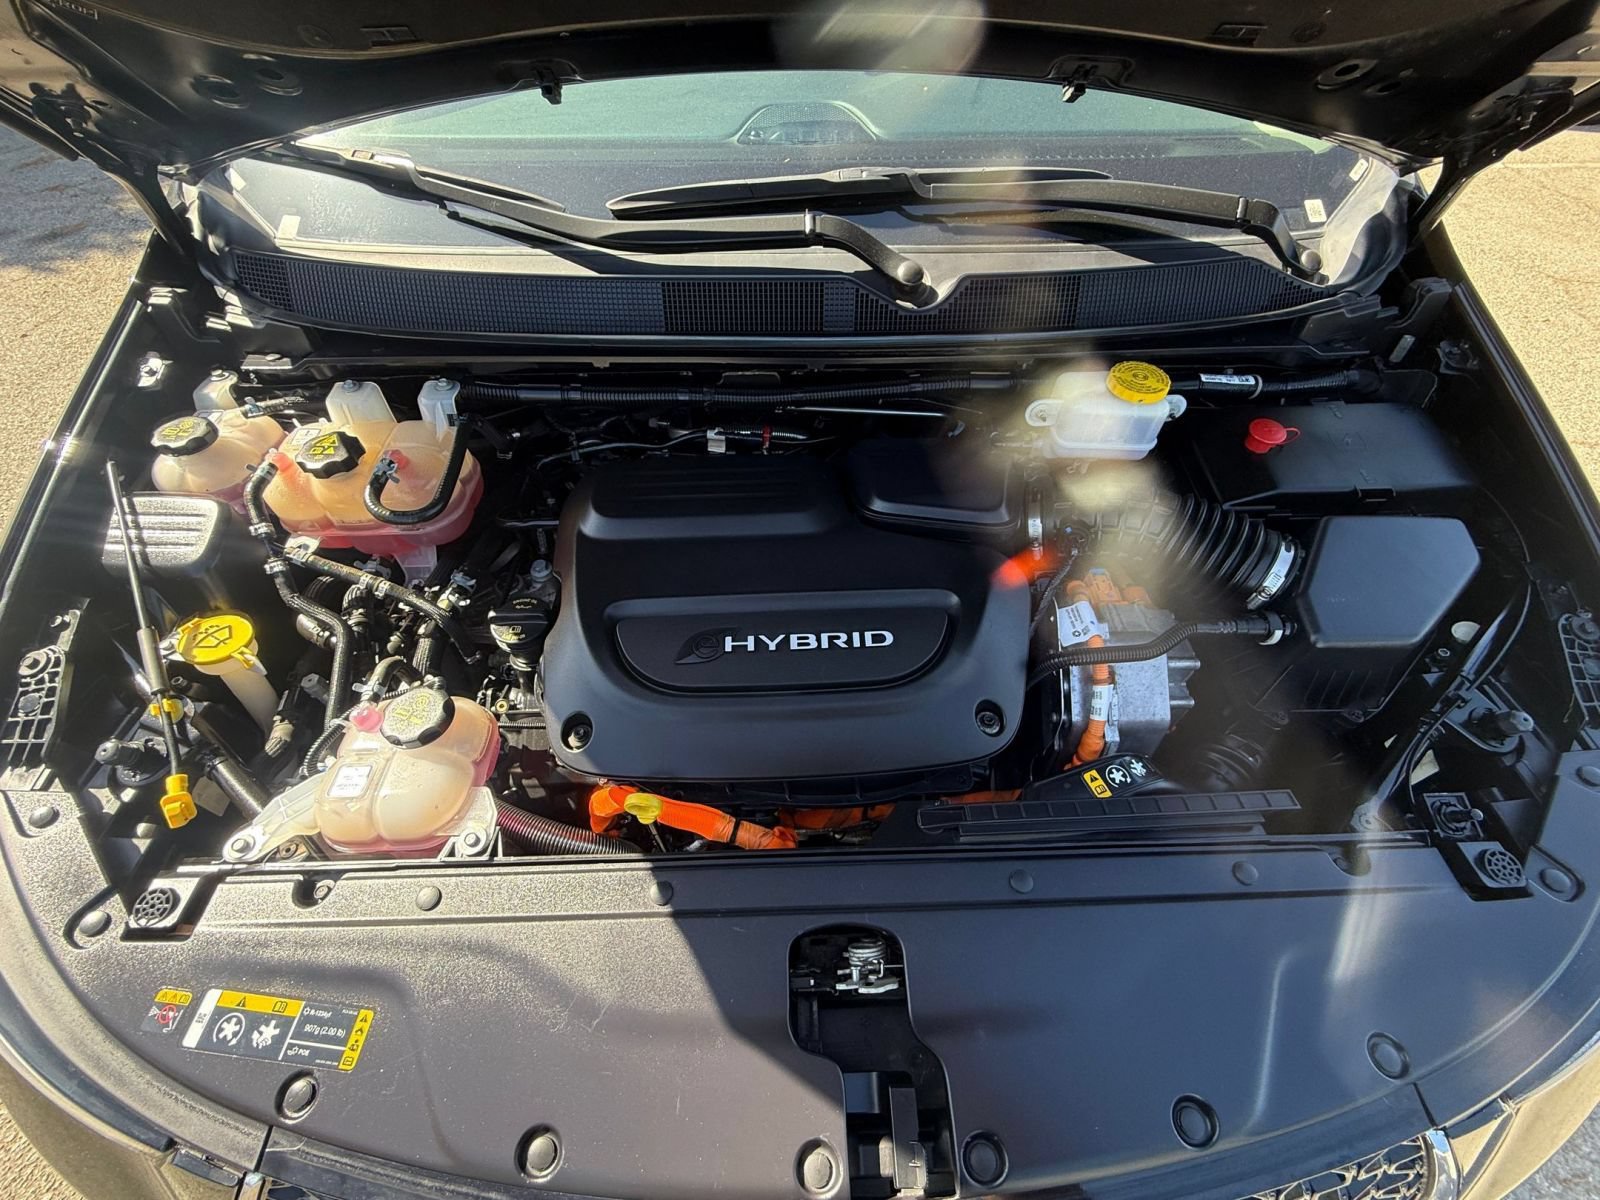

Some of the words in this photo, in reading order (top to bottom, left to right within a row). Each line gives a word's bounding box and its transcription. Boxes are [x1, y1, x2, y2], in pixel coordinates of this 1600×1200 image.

[724, 630, 894, 652] HYBRID
[304, 1023, 321, 1035] 907g
[320, 1026, 337, 1036] (2.00
[336, 1028, 346, 1039] lb)
